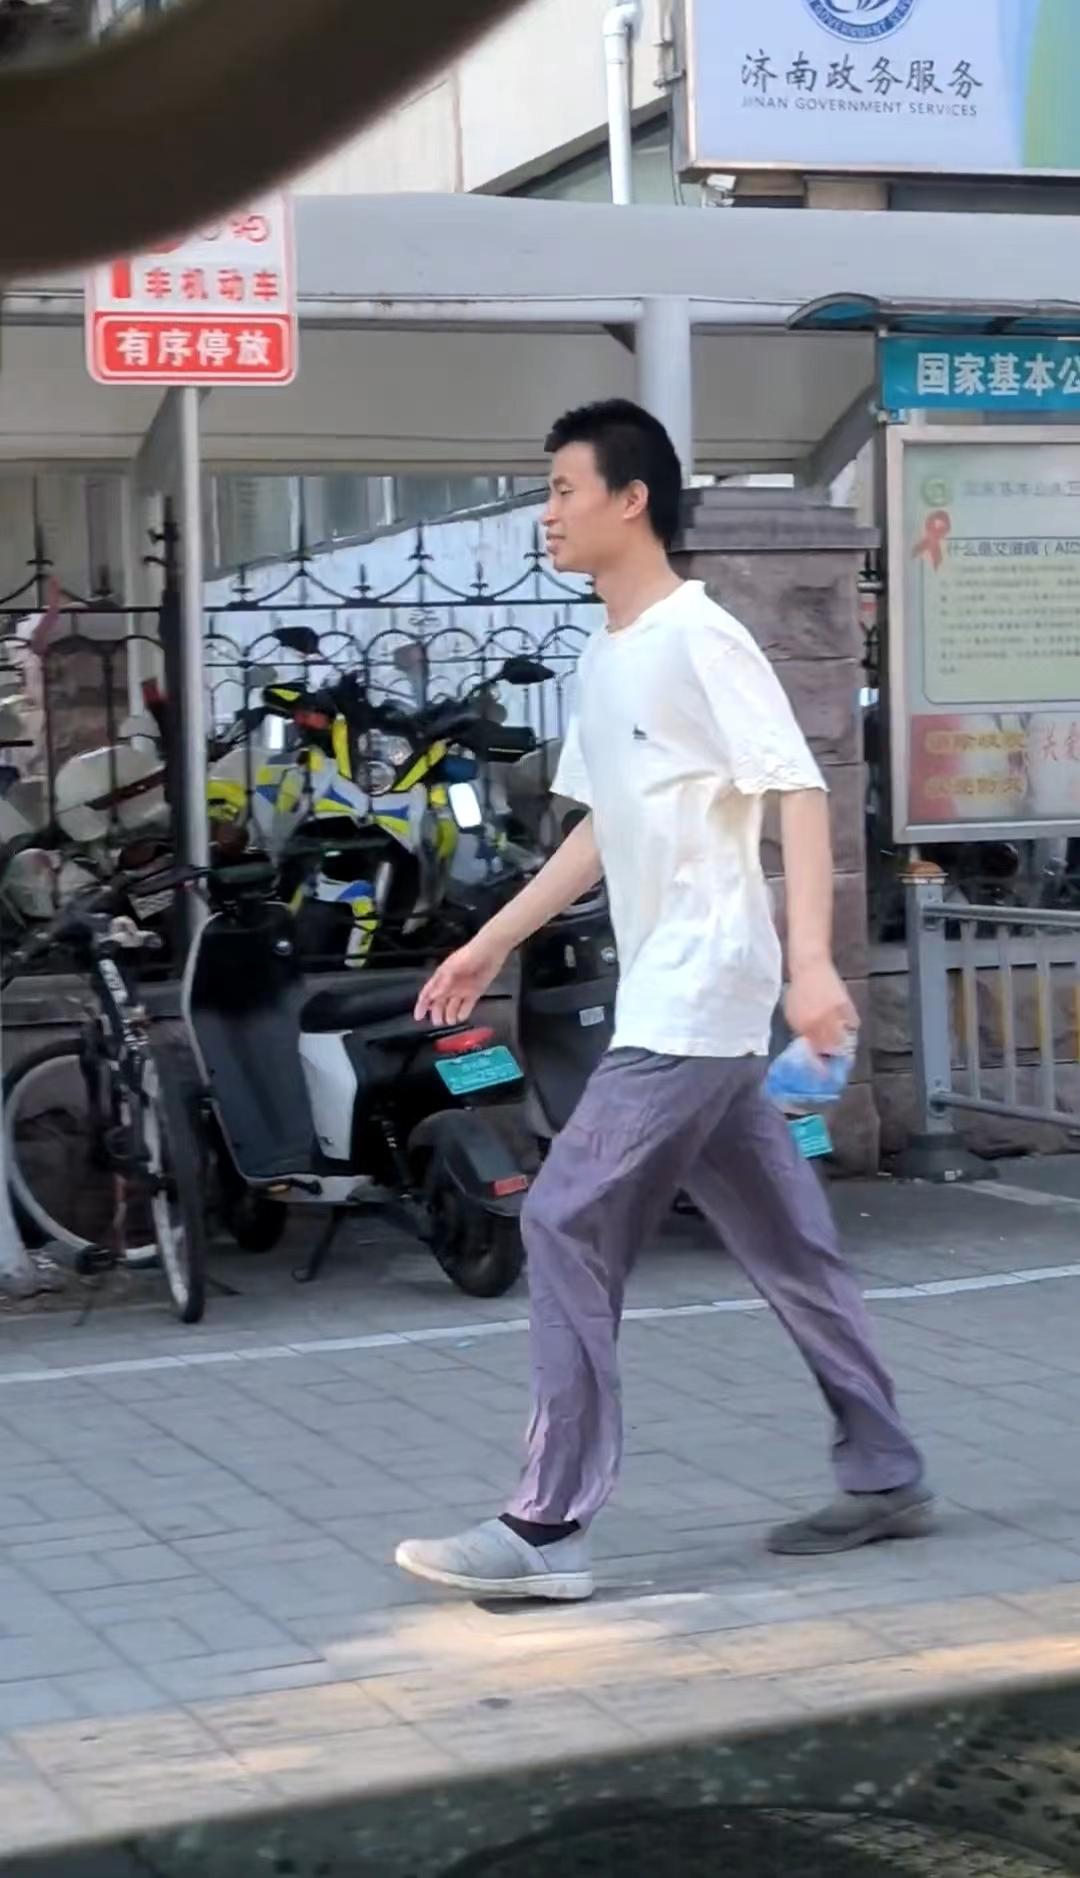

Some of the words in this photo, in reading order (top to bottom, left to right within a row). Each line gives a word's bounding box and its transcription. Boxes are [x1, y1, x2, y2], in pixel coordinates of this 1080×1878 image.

[741, 49, 983, 99] 济南政务服务
[742, 97, 788, 110] JINAN
[795, 99, 901, 114] GOVERNMENT
[909, 103, 977, 117] SERVICES
[145, 267, 278, 300] 非机动车
[116, 328, 271, 366] 有序停放
[916, 352, 1080, 396] 国家基本公
